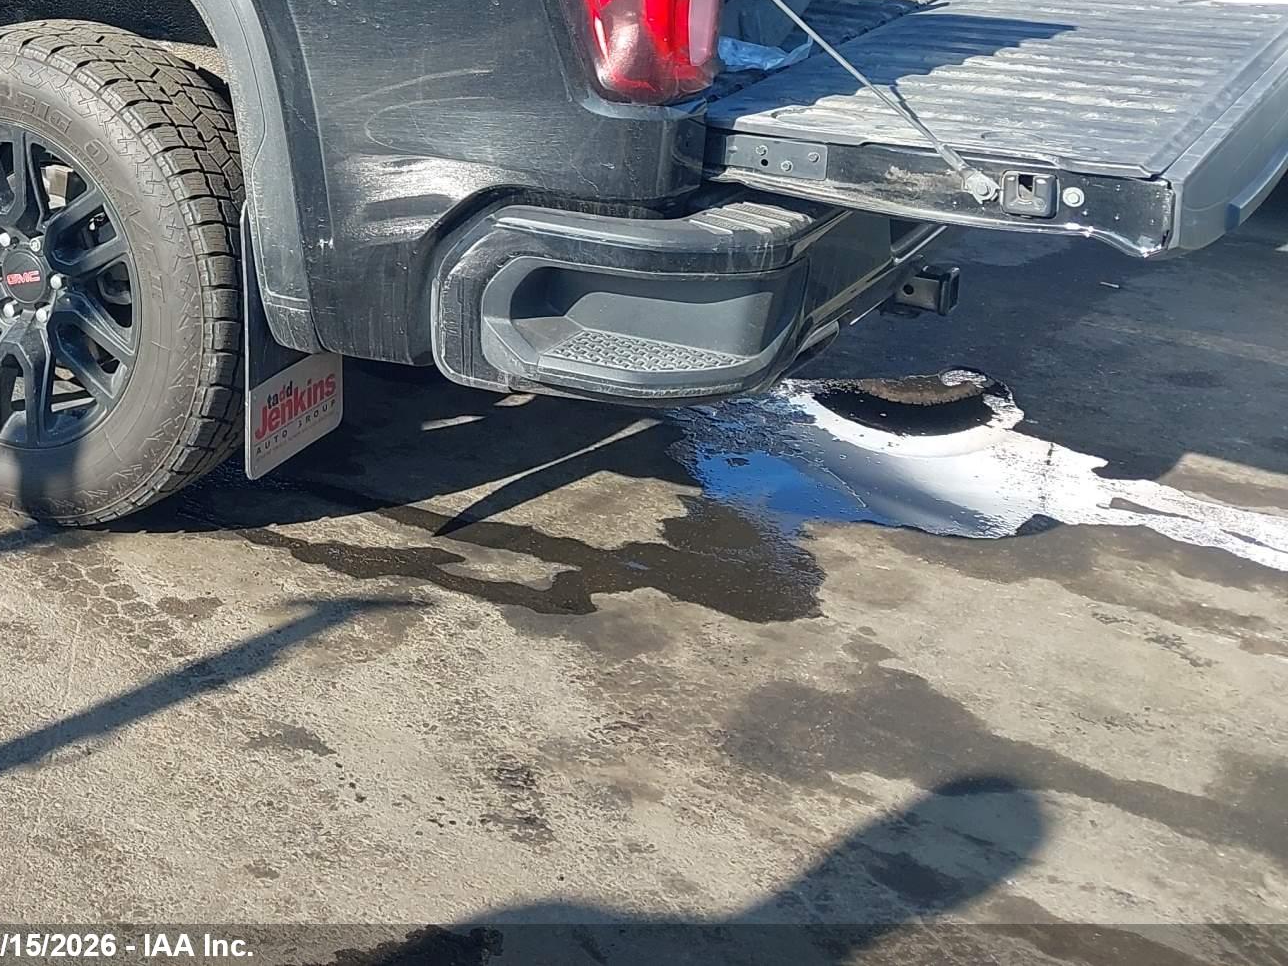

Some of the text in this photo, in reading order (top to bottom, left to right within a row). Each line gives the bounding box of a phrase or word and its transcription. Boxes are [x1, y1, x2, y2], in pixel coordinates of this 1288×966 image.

[6, 270, 41, 285] GMC
[255, 374, 337, 440] Jenkins
[267, 380, 292, 409] tadd
[256, 429, 288, 454] AUTO
